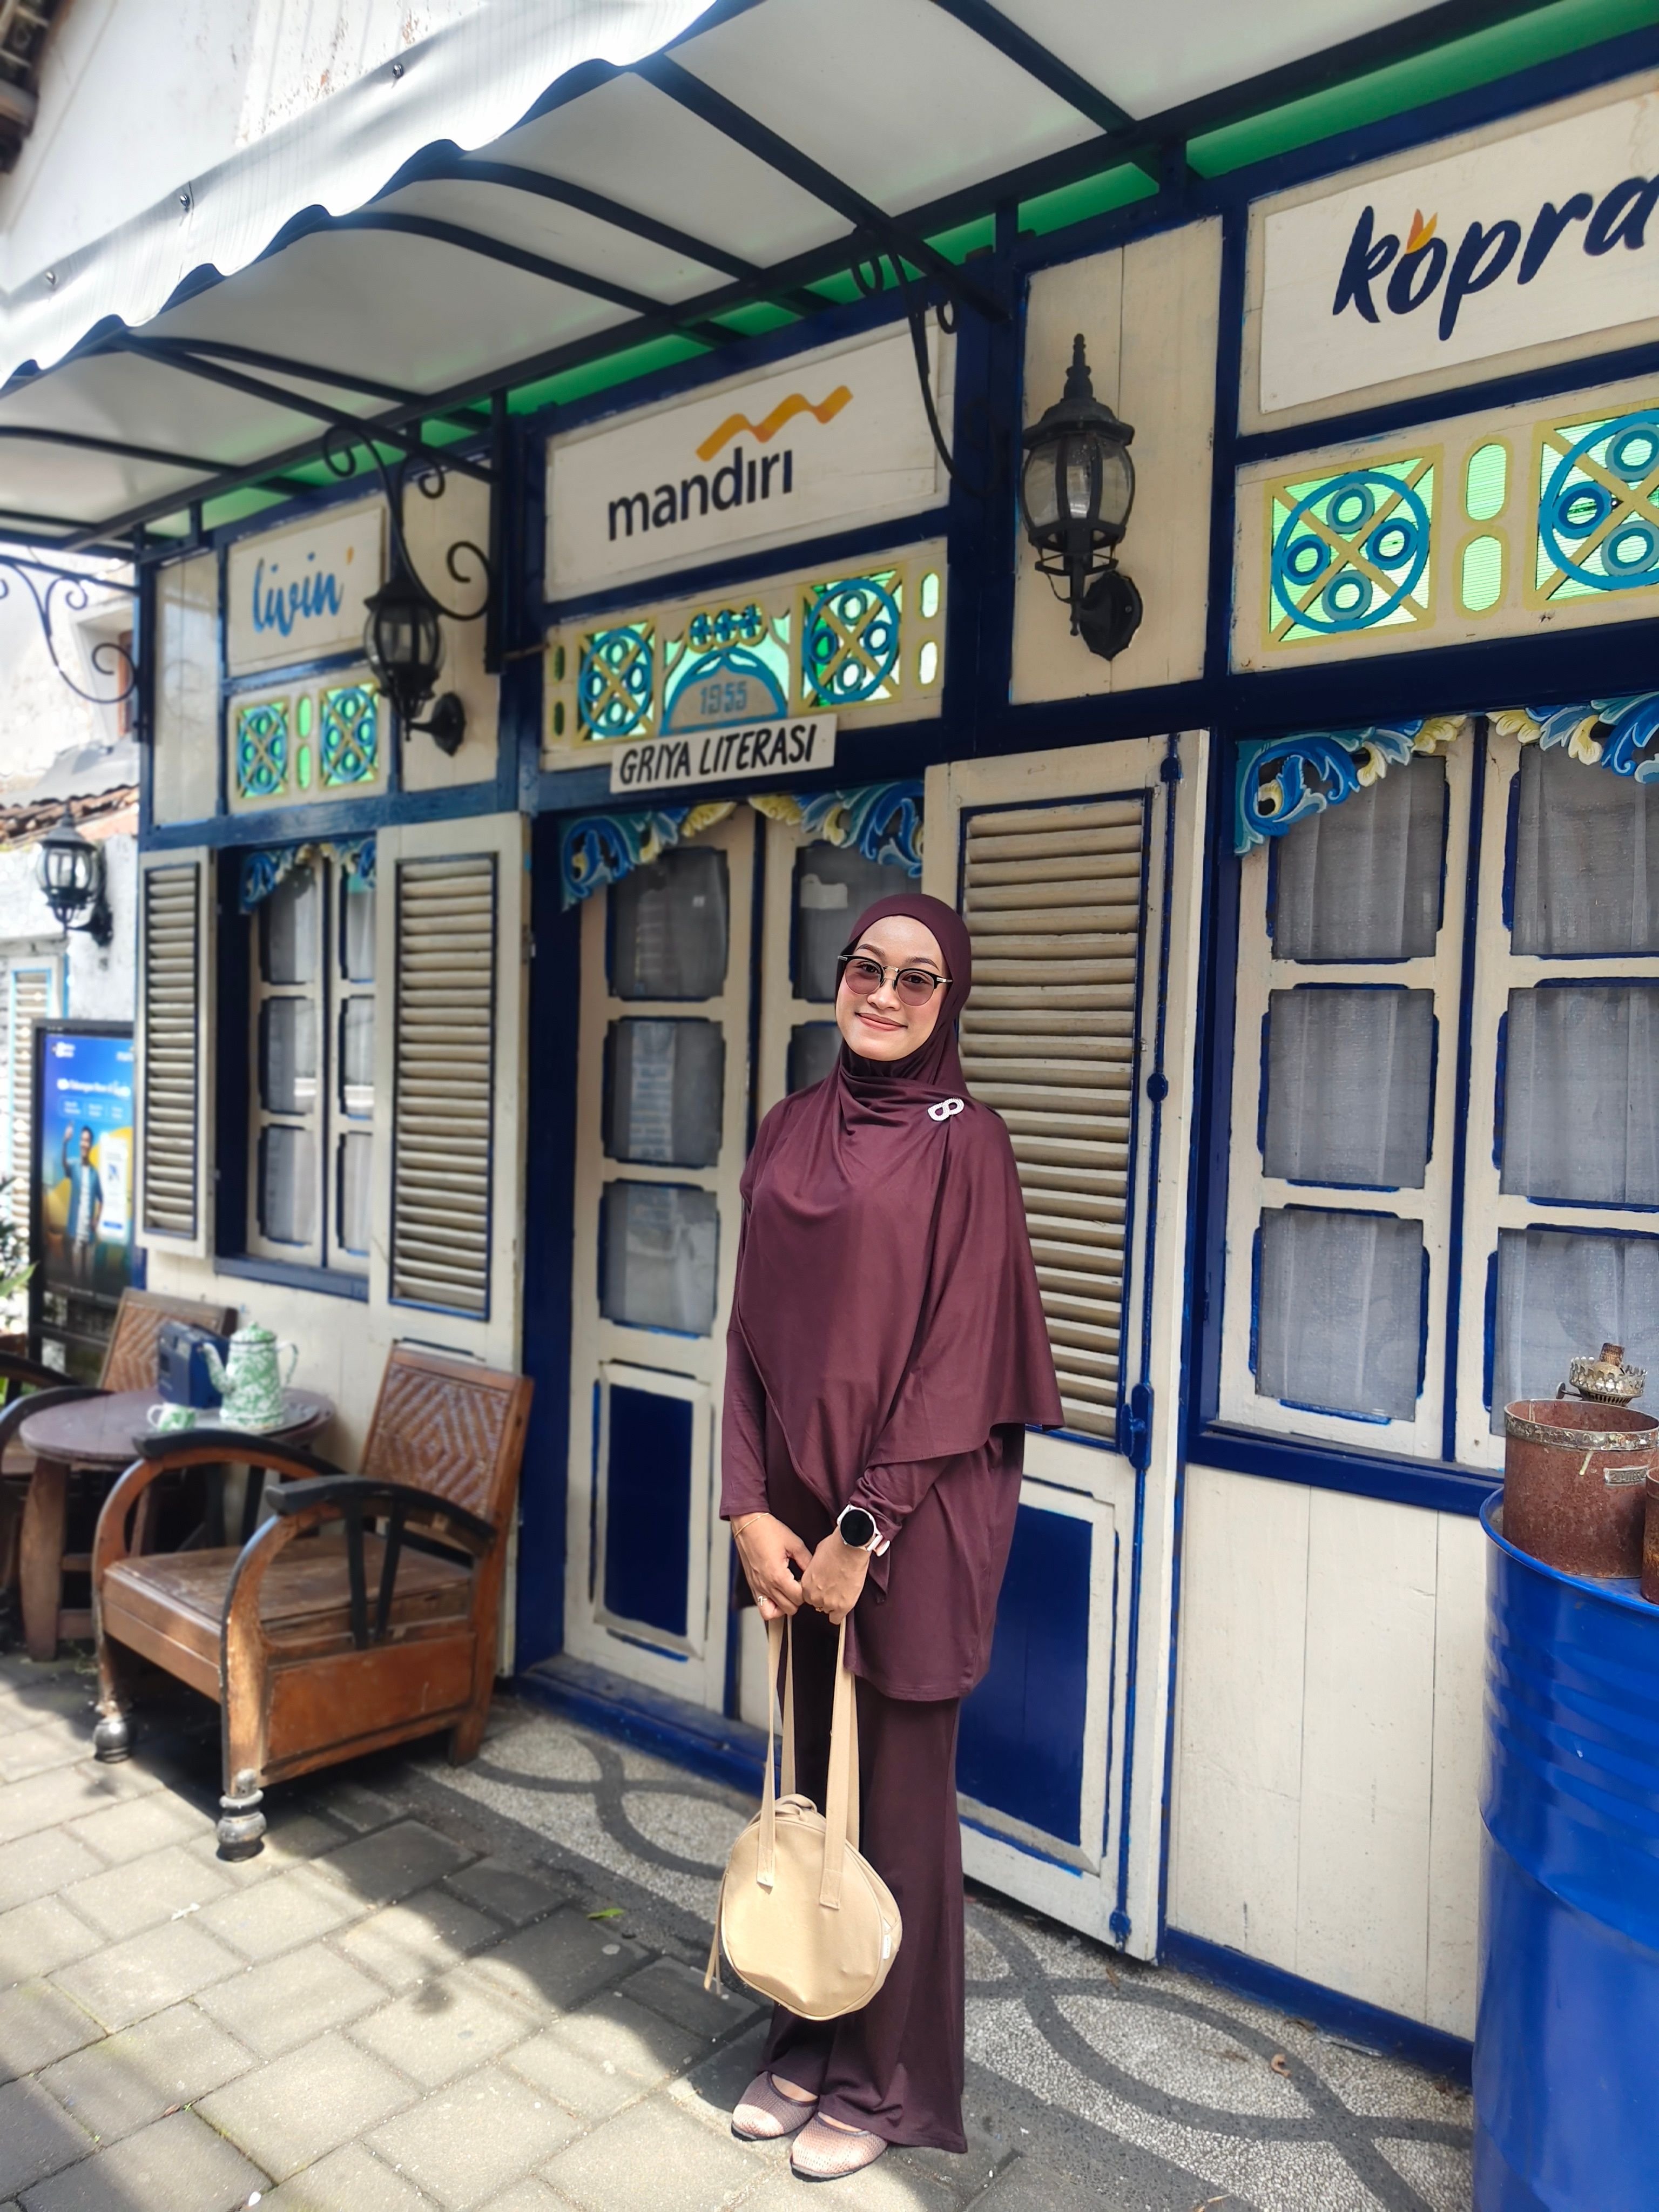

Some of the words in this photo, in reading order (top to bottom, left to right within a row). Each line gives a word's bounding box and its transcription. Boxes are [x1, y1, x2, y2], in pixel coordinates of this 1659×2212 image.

[1332, 173, 1659, 341] kopra
[608, 447, 793, 541] mandiri
[700, 680, 747, 715] 1955
[619, 741, 691, 785] GRIYA
[699, 724, 817, 776] LITERASI
